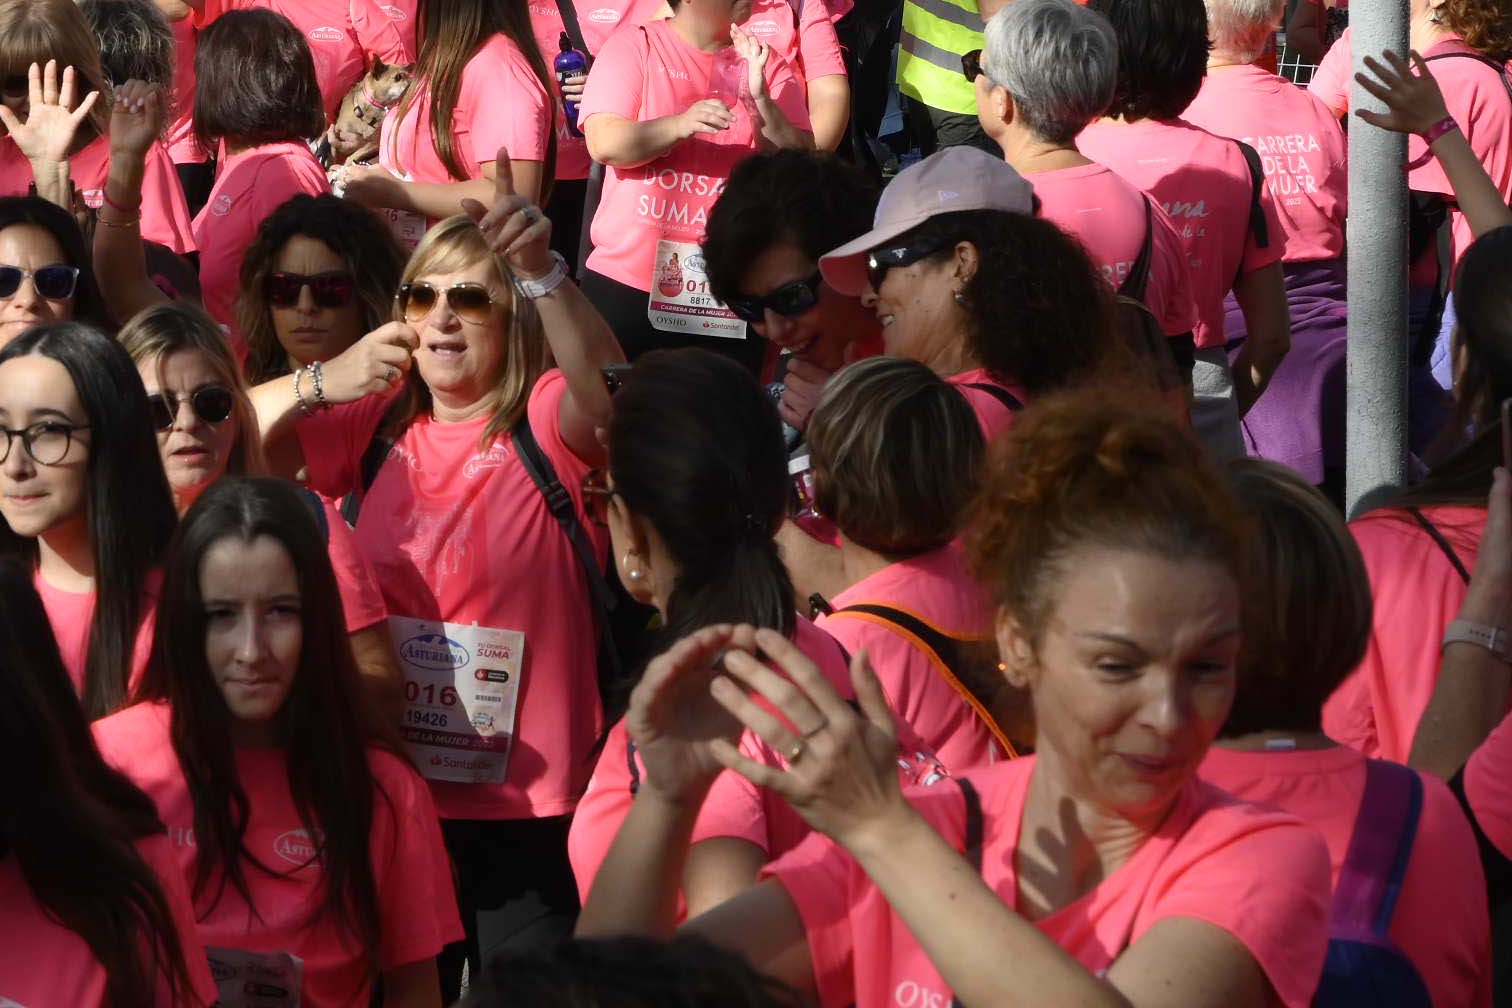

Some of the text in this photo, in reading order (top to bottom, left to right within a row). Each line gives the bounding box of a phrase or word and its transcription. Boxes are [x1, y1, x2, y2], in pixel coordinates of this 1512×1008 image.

[1243, 134, 1321, 156] ARRERA
[1287, 155, 1310, 176] LA
[643, 164, 726, 198] DORSA
[638, 194, 708, 228] SUMA
[686, 279, 708, 294] 01
[476, 648, 510, 660] SUMA
[405, 680, 458, 706] 016
[406, 709, 448, 728] 19426
